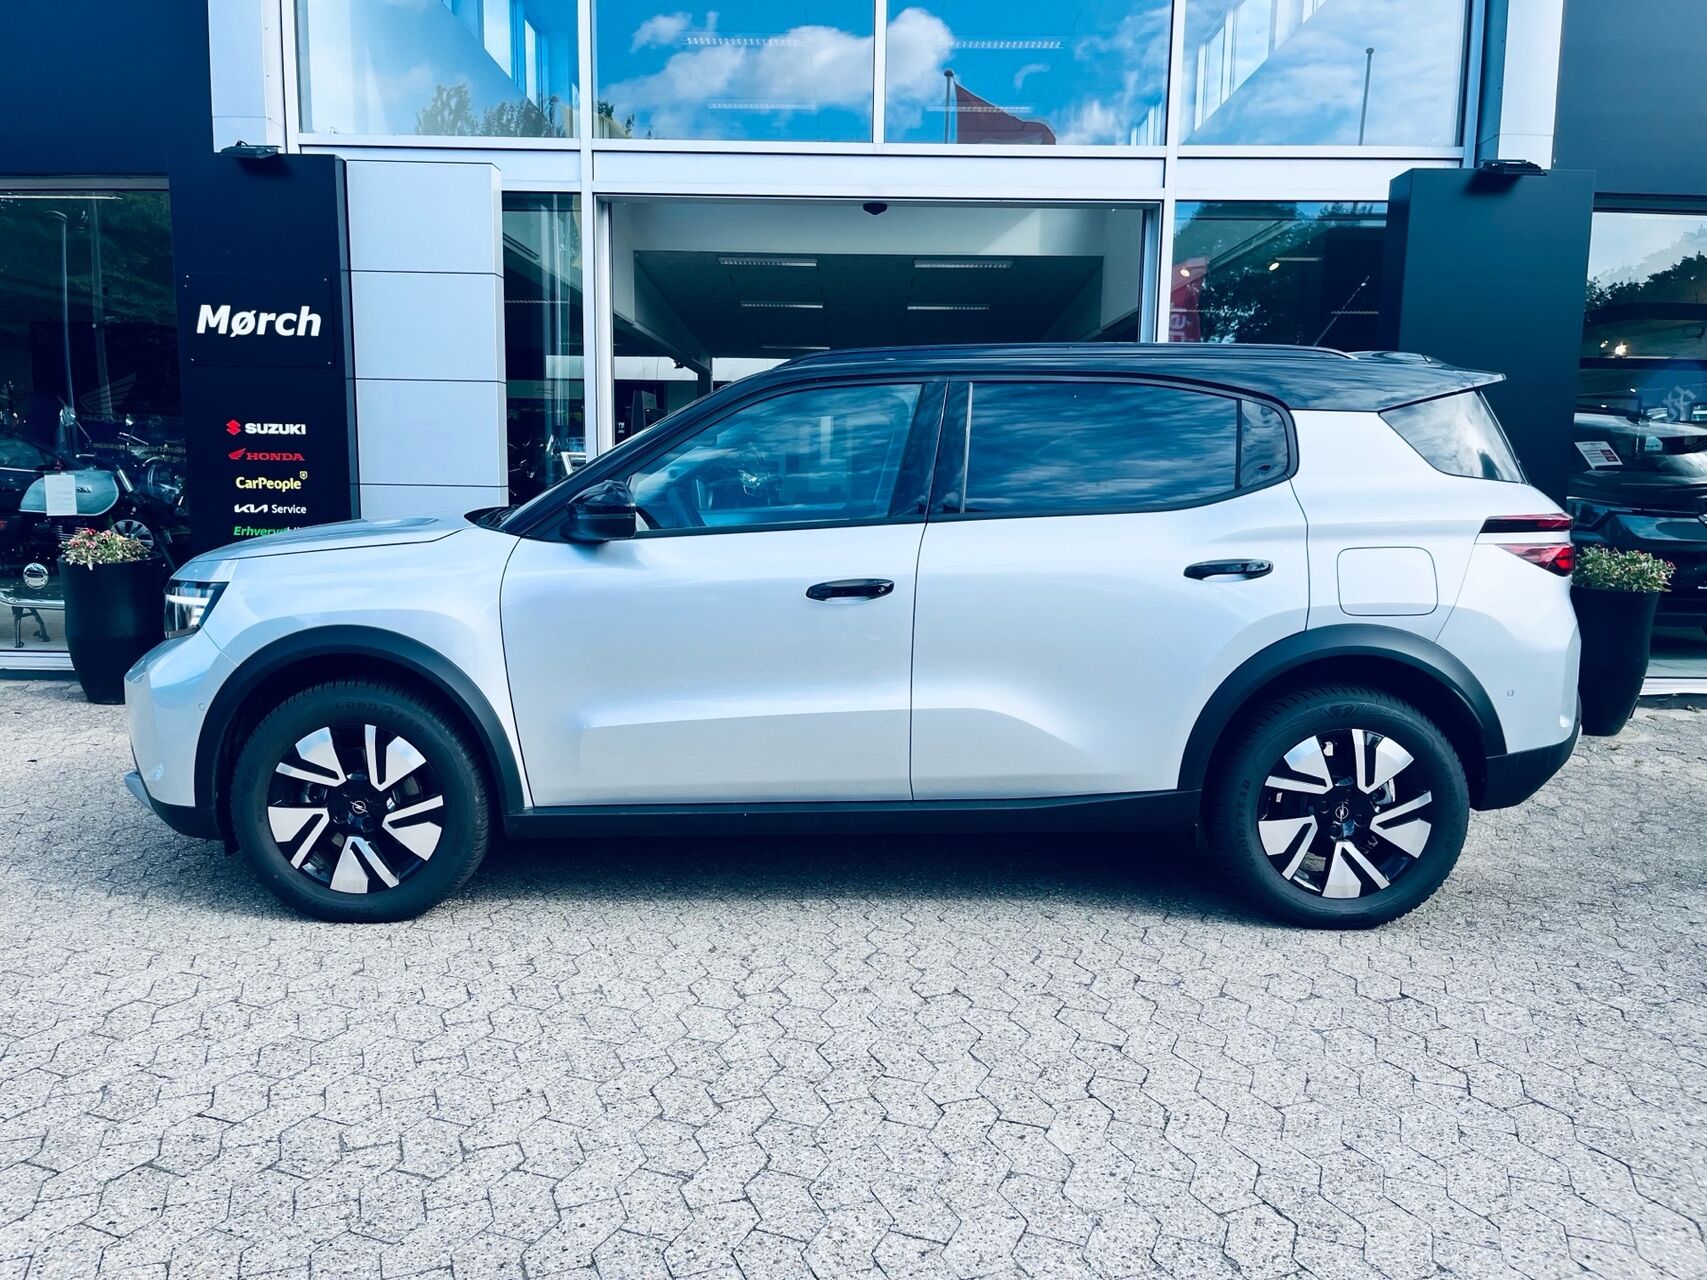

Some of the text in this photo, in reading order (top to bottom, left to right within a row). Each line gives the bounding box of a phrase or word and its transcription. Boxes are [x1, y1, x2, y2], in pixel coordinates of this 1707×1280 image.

[196, 304, 322, 338] Mørch
[244, 422, 307, 436] SUZUKI
[246, 452, 305, 462] HONDA
[235, 476, 302, 493] CarPeople
[271, 503, 307, 515] Service
